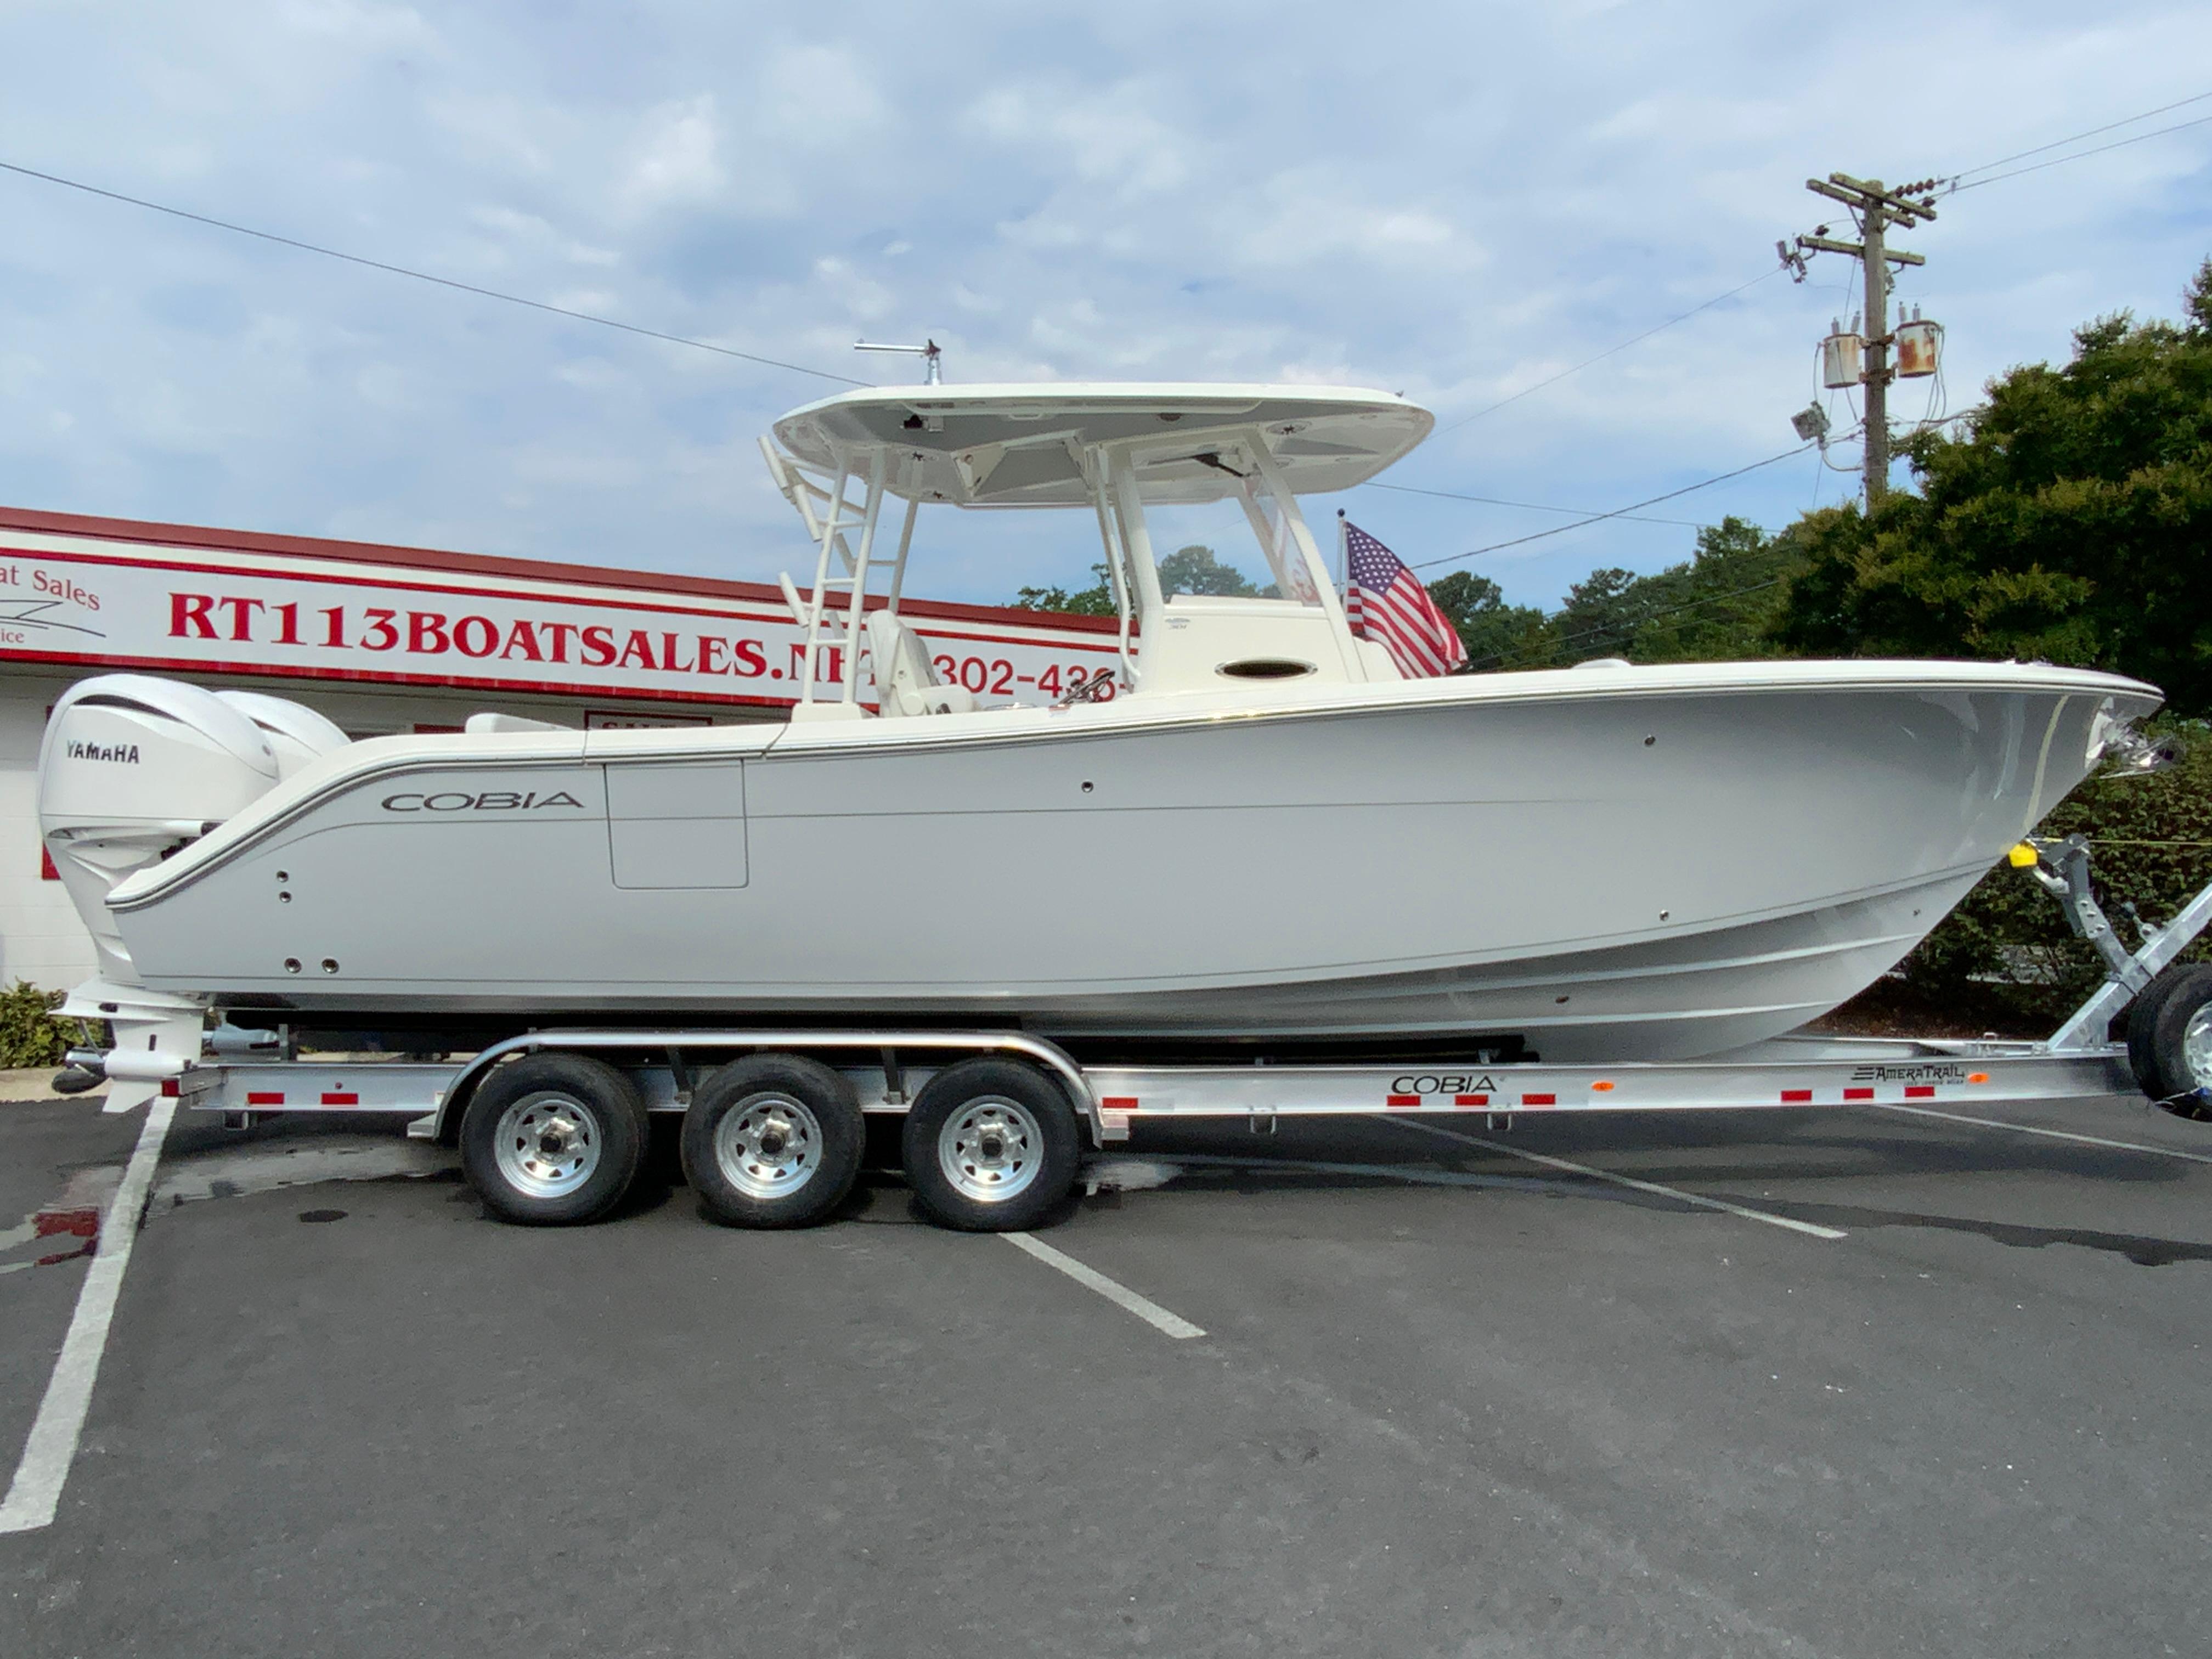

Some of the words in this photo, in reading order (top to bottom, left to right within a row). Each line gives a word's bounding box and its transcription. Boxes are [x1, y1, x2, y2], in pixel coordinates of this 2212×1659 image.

[33, 569, 100, 611] Sales
[67, 740, 139, 764] YAMAHA
[381, 792, 585, 812] COBIA
[1391, 1075, 1498, 1094] COBIA
